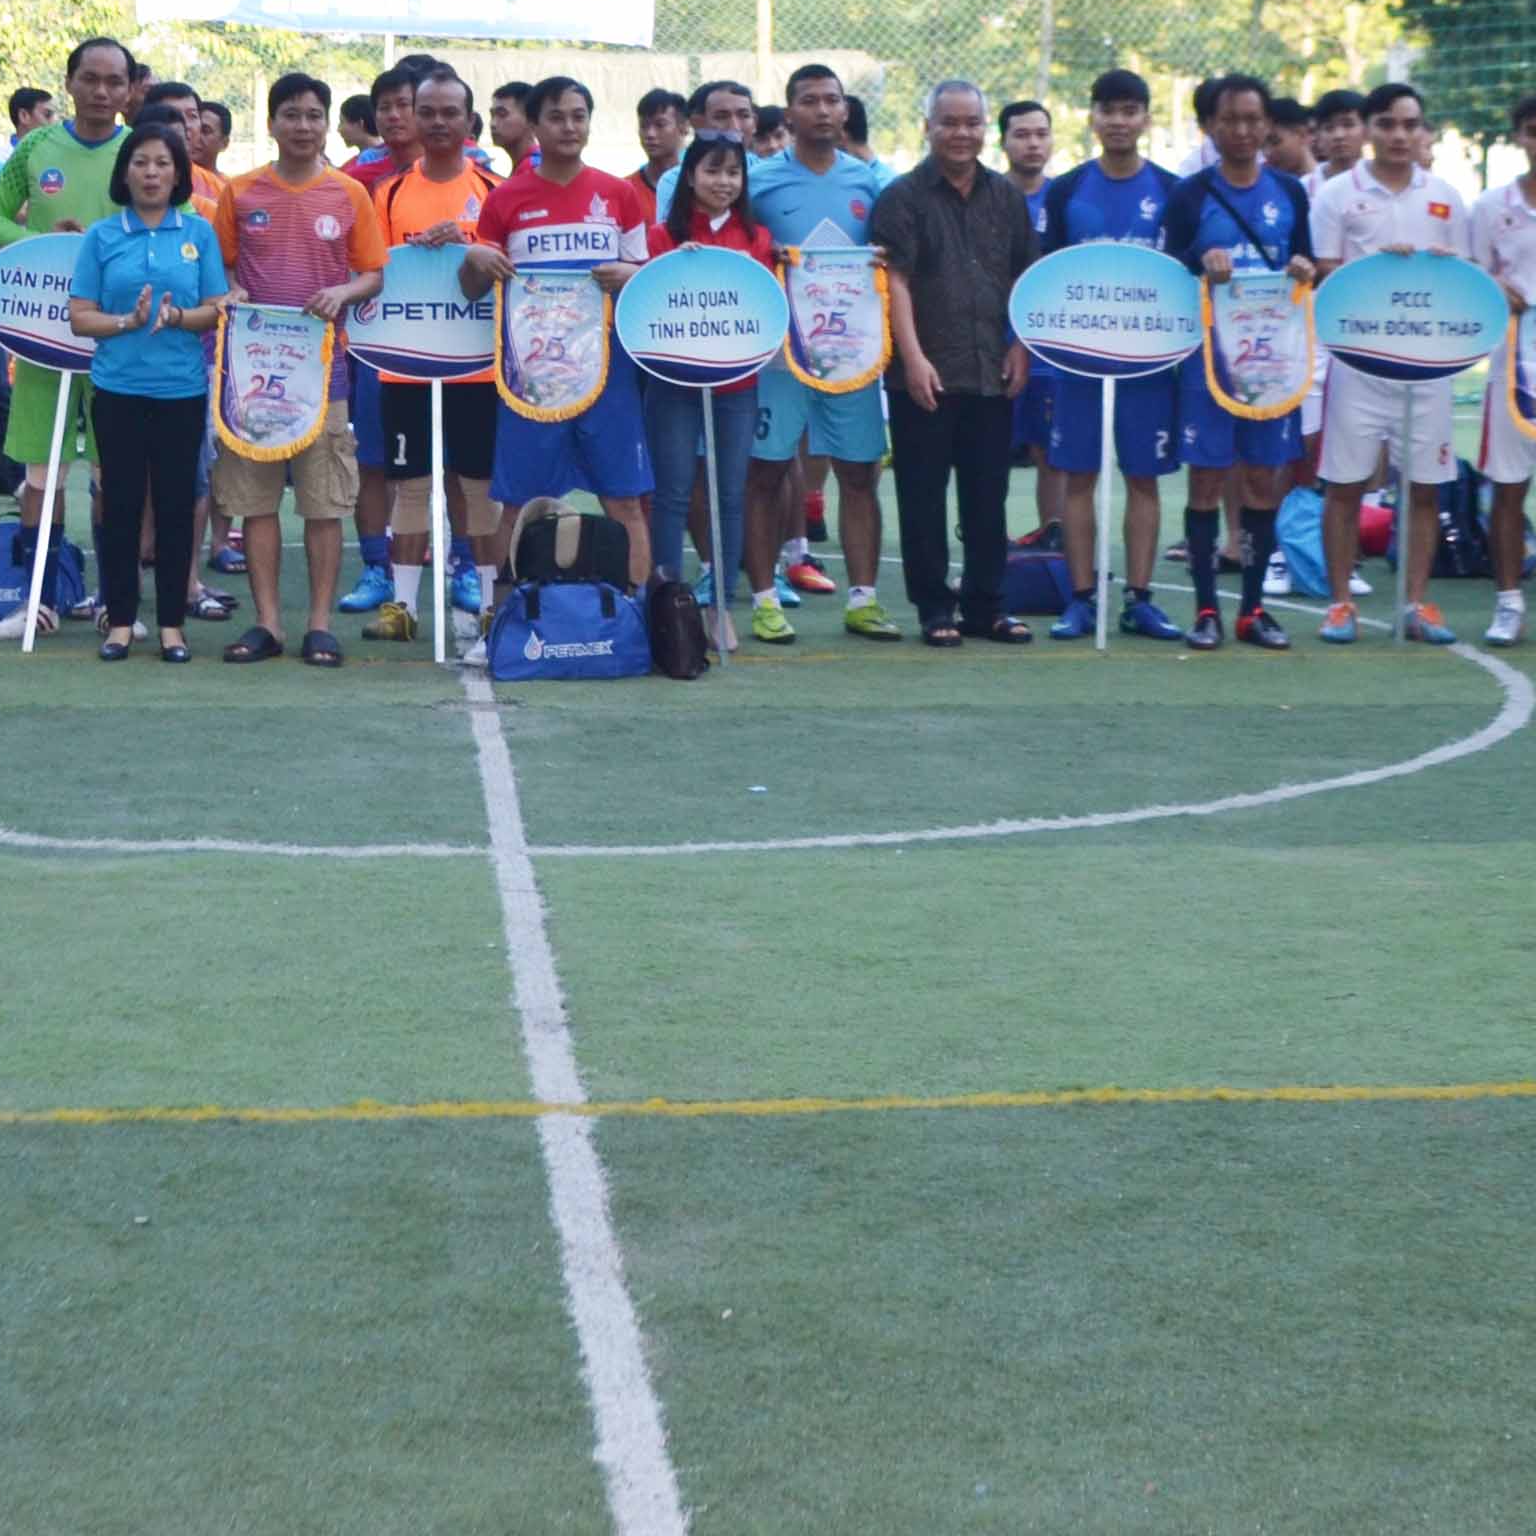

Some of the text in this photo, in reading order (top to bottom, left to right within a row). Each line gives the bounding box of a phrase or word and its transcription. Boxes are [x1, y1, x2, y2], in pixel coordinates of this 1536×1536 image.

[527, 232, 610, 254] PETIMEX
[0, 267, 36, 288] VĂN
[0, 294, 42, 320] TỈNH
[668, 287, 738, 310] HẢI QUAN
[1392, 292, 1432, 307] PCCC
[734, 319, 760, 334] NAI
[809, 311, 847, 339] 25
[525, 336, 565, 363] 25
[1233, 338, 1272, 367] 25
[244, 374, 287, 402] 25
[394, 431, 407, 465] 1
[544, 640, 613, 658] PETIMEX
